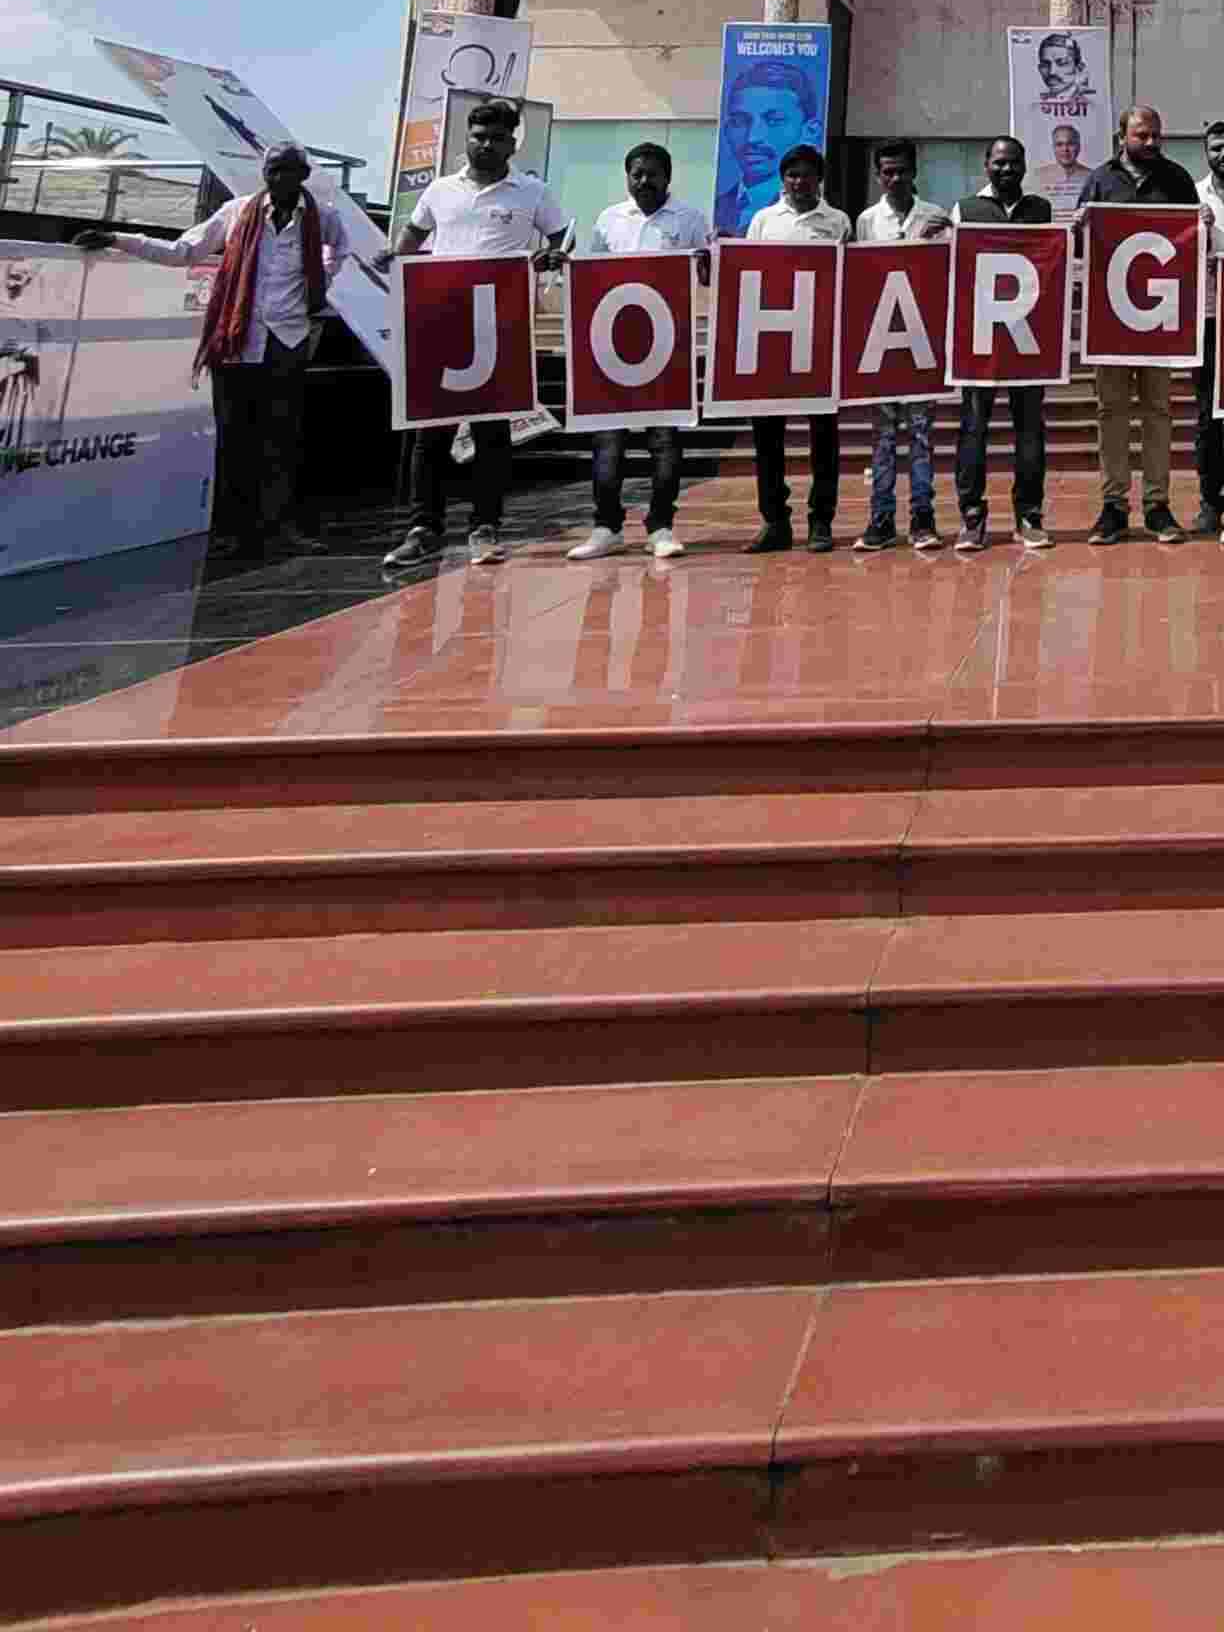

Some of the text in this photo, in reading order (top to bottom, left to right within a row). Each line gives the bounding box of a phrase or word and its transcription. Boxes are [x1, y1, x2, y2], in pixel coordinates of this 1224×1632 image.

[737, 39, 794, 56] WELCOMES
[406, 170, 433, 186] YO
[47, 431, 137, 466] CHANGE
